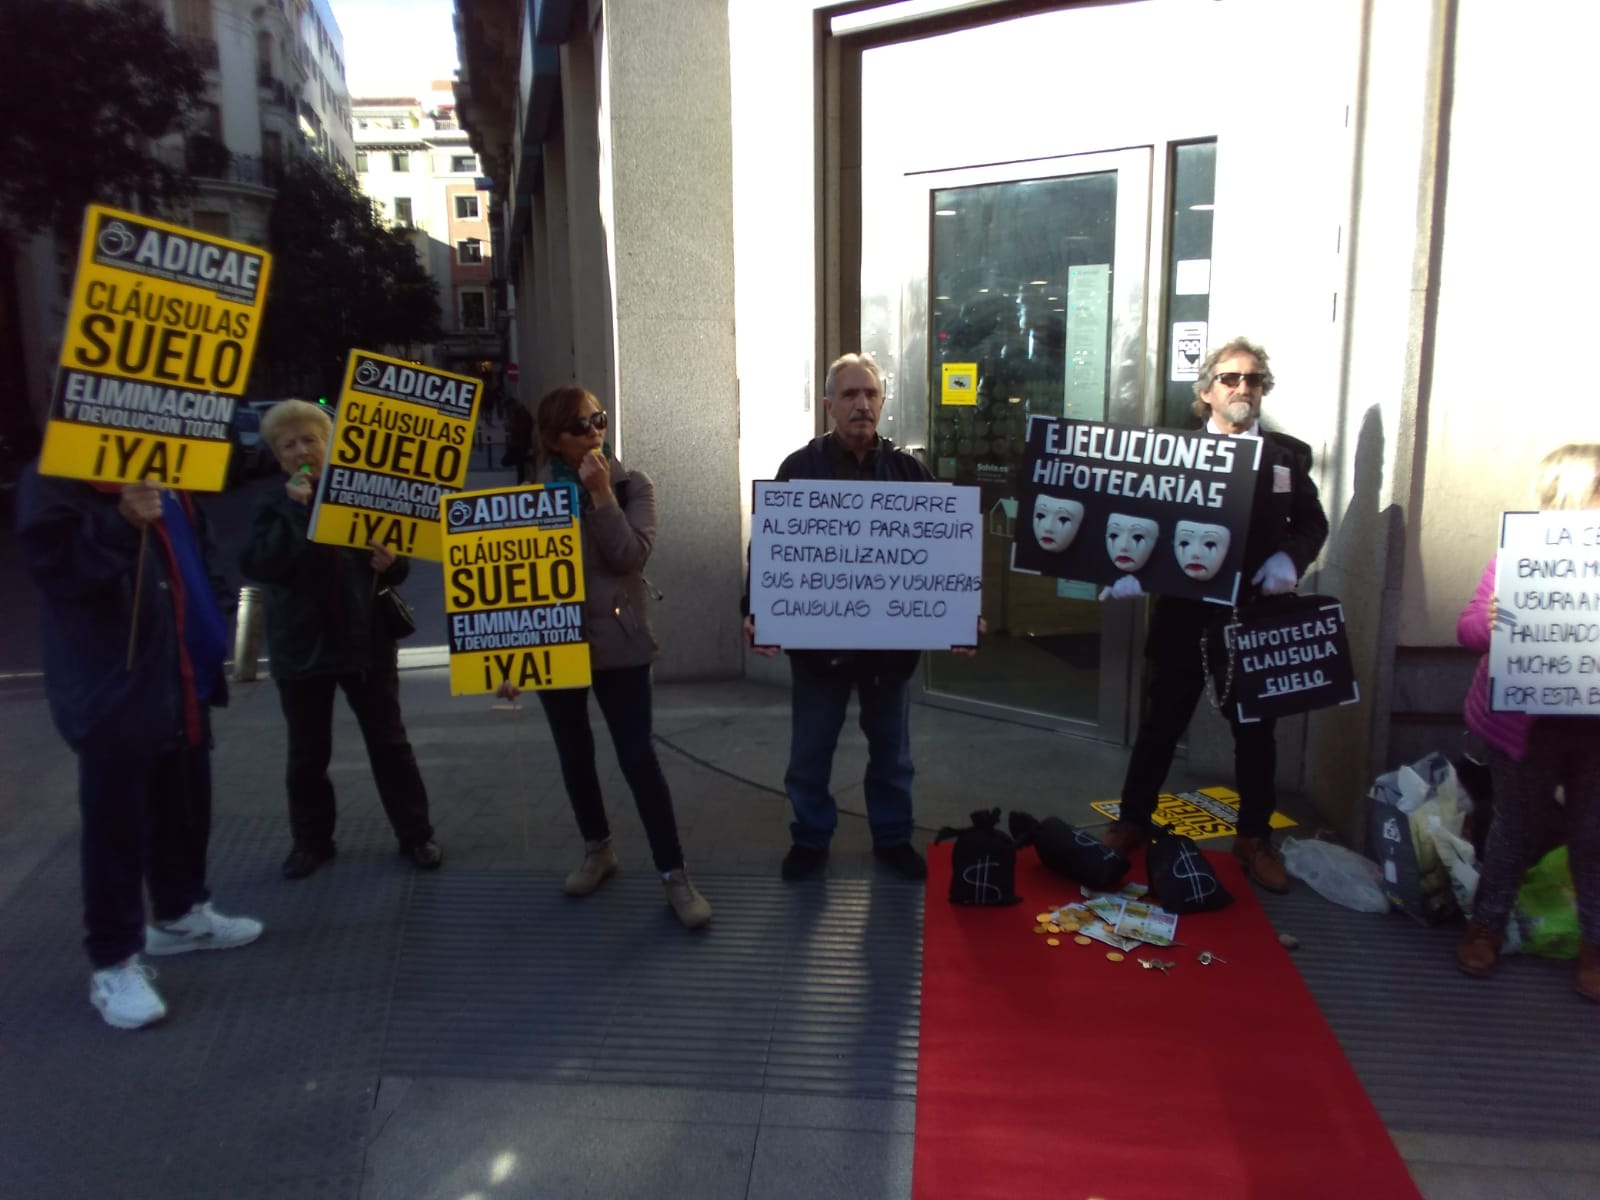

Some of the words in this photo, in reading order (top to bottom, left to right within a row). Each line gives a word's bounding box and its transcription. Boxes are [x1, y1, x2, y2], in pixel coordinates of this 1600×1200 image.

[136, 231, 260, 289] ADICAE
[87, 281, 250, 339] CLÁUSULAS
[74, 314, 243, 389] SUELO
[65, 372, 235, 423] ELIMINACIÓN
[379, 365, 475, 409] ADICAE
[63, 402, 76, 419] Y
[77, 404, 181, 435] DEVOLUCIÓN
[185, 420, 228, 439] TOTAL
[345, 401, 467, 446] CLÁUSULAS
[93, 434, 188, 484] ¡YA!
[338, 426, 462, 483] SUELO
[1045, 423, 1237, 474] EJECUCIONES
[329, 489, 339, 502] Y
[338, 491, 413, 516] DEVOLUCIÓN
[415, 504, 440, 520] TOT
[331, 468, 458, 507] ELIMINACIÓ
[764, 490, 805, 507] ESTE
[809, 490, 864, 510] BANCO
[870, 492, 958, 514] RECURRE
[473, 488, 570, 524] ADICAE
[349, 512, 418, 553] ¡YA!
[1545, 527, 1573, 545] LA
[450, 534, 574, 568] CLÁUSULAS
[770, 543, 929, 565] RENTABILIZANDO
[1518, 558, 1577, 579] BANCA
[451, 558, 577, 609] SUELO
[761, 571, 794, 589] SUS
[800, 569, 887, 590] ABUSIVAS
[771, 599, 870, 617] CLAUSULAS
[886, 599, 947, 618] SUELO
[1514, 591, 1575, 610] USURA
[453, 602, 583, 637] ELIMINACIÓN
[1237, 617, 1338, 651] HIPOTECAS
[454, 637, 463, 651] Y
[465, 629, 541, 650] DEVOLUCIÓN
[542, 627, 583, 643] TOTAL
[484, 651, 553, 690] ¡YA!
[1241, 641, 1339, 673] CLAUSULA
[1507, 655, 1573, 675] MUCHAS
[1265, 670, 1326, 695] SUELO
[1504, 686, 1538, 706] POR
[1543, 687, 1583, 706] ESTA
